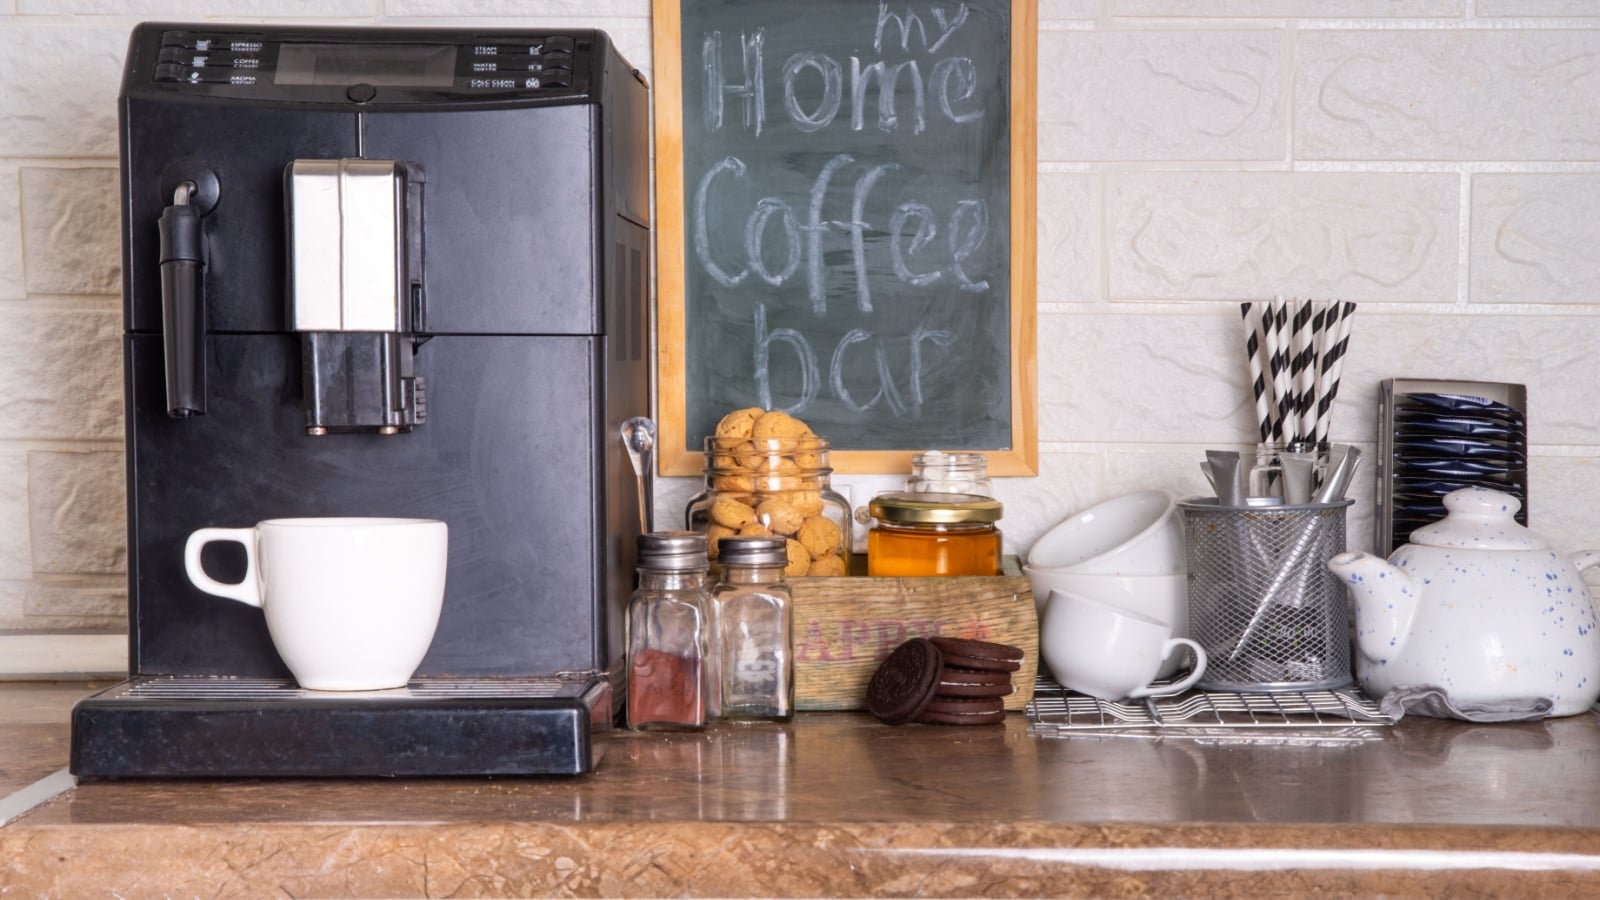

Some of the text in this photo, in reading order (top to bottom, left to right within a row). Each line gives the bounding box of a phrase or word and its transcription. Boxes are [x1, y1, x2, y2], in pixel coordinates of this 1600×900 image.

[702, 26, 986, 137] Home
[874, 1, 970, 55] my
[695, 153, 990, 317] Coffee
[754, 303, 956, 416] bar
